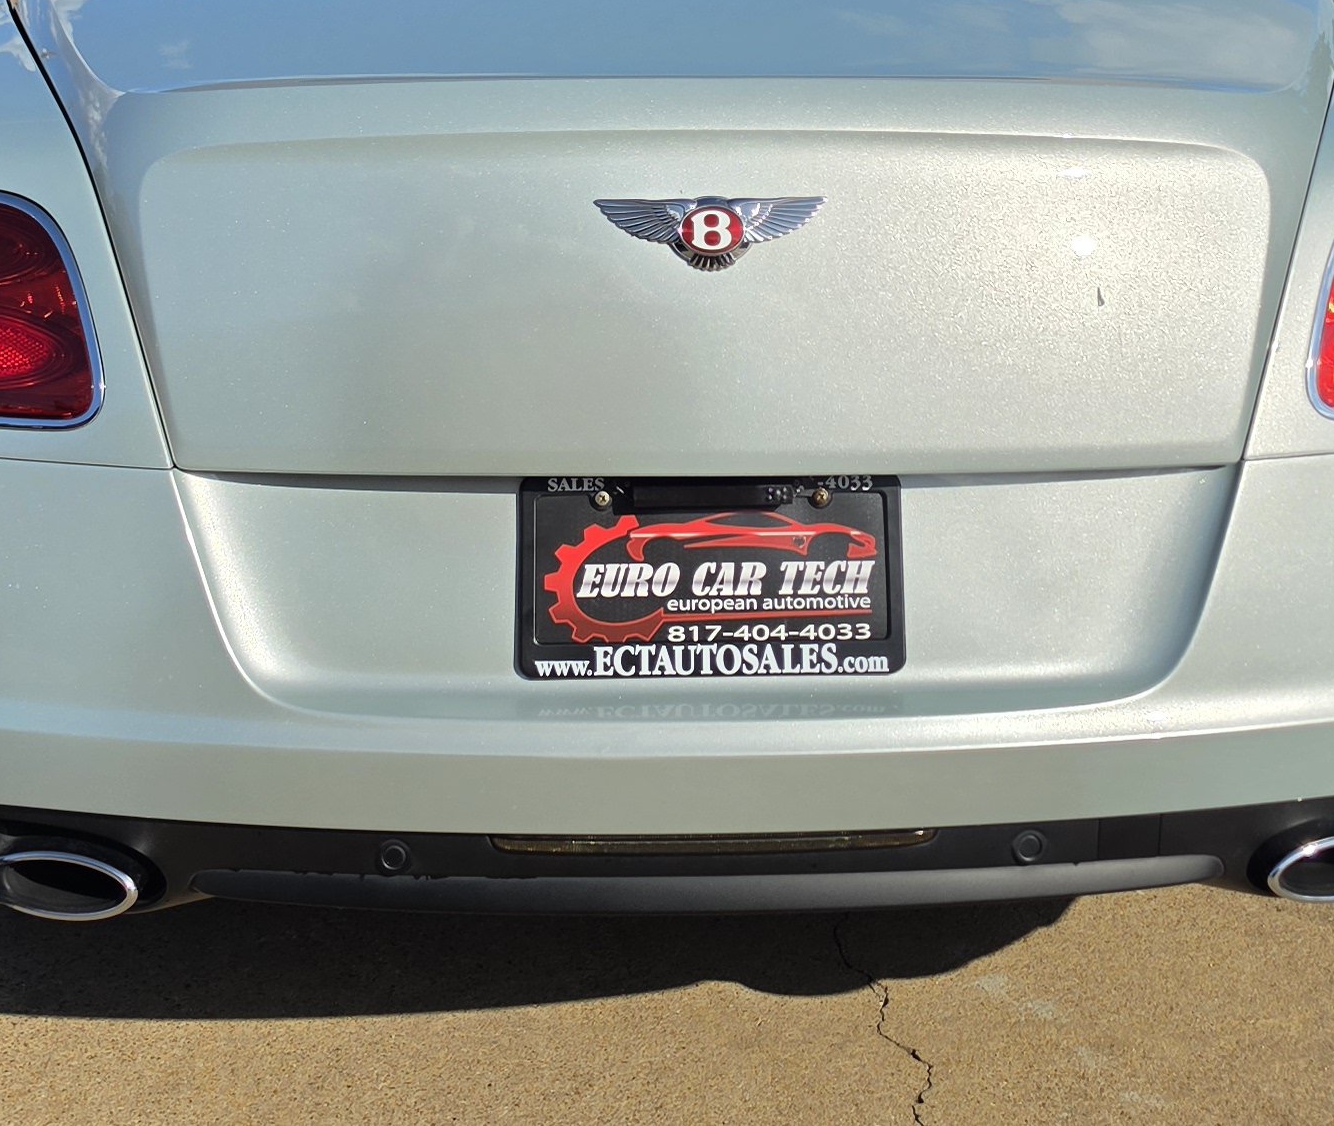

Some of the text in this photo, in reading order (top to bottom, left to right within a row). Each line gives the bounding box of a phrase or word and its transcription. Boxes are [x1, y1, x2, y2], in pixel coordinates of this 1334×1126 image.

[690, 209, 733, 250] B
[547, 477, 605, 492] SALES
[576, 560, 876, 598] EURO CAR TECH
[666, 594, 871, 614] european automotive
[667, 622, 872, 641] 817-404-4033
[534, 642, 890, 677] www.ECTAUTOSALES.com
